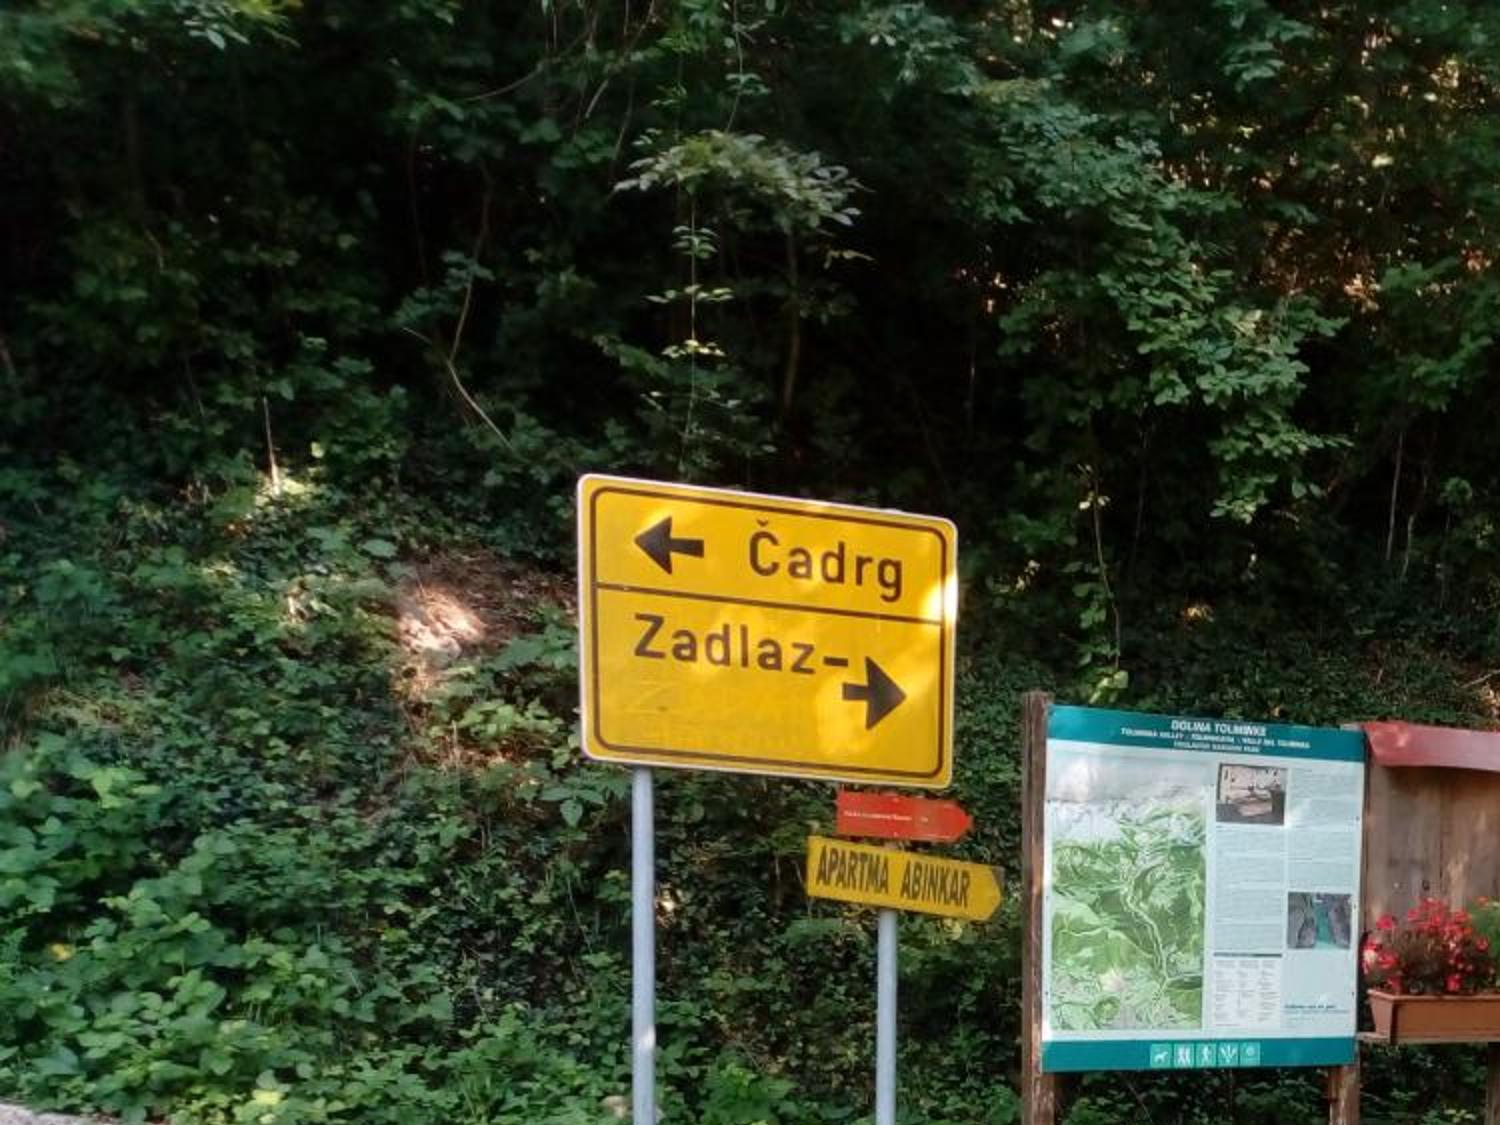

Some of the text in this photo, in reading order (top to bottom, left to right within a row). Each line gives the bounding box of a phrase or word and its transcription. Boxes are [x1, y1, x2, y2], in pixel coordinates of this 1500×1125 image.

[749, 518, 902, 603] Čadrg
[633, 612, 849, 675] Zadlaz-
[815, 844, 971, 909] APARTMA ABINKAR
